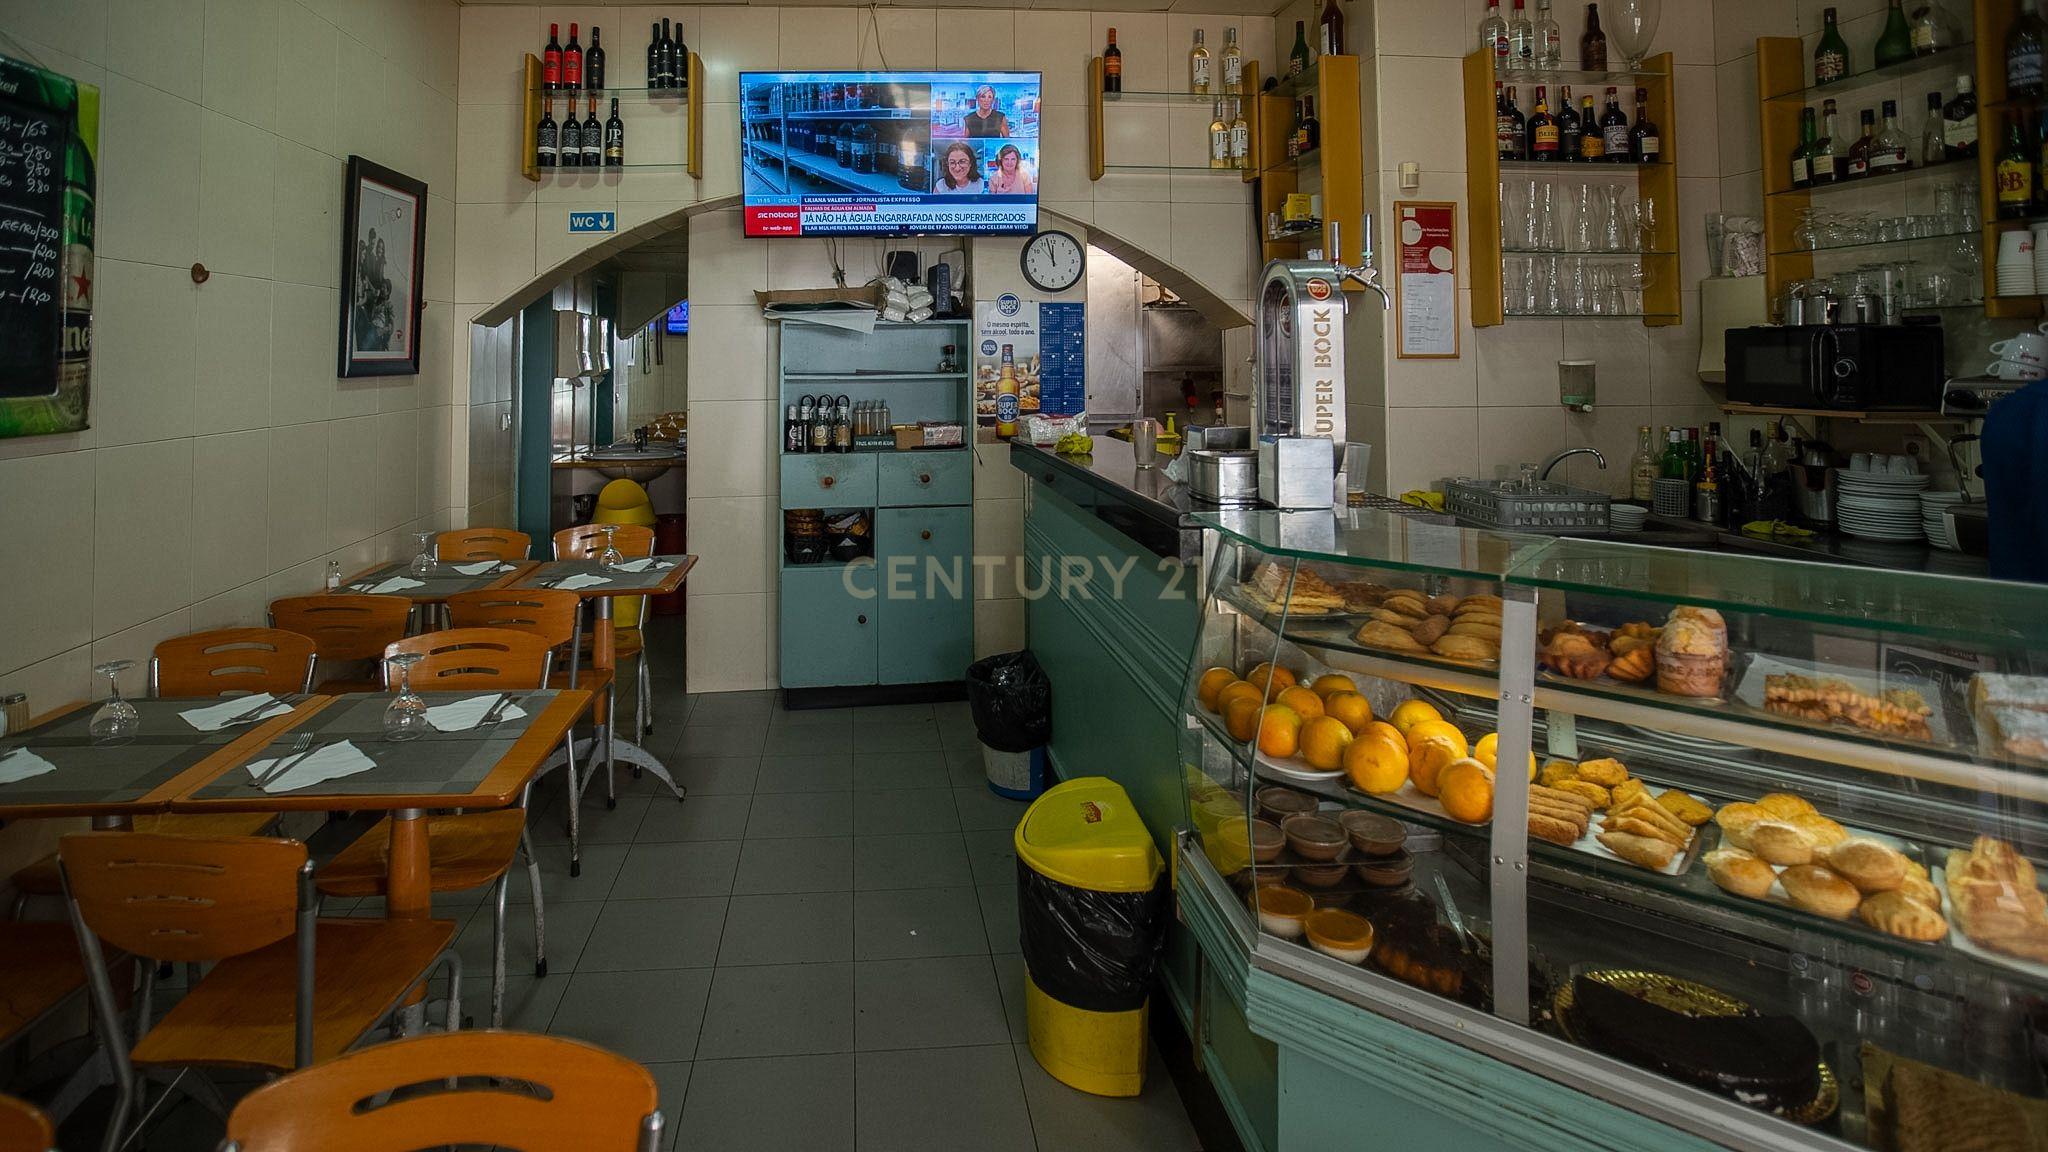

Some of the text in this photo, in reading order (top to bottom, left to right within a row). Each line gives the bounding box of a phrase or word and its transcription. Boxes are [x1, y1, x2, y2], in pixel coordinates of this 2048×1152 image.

[1195, 59, 1209, 73] JP
[1225, 57, 1239, 72] JP
[607, 129, 622, 143] JP
[1216, 132, 1228, 146] JP
[1233, 129, 1247, 143] JP
[572, 216, 595, 228] WC
[804, 211, 1026, 224] JÁ NÃO HÁ ÁGUA ENGARRAFADA NOS SUPERMERCADOS
[1313, 308, 1332, 368] BOCK
